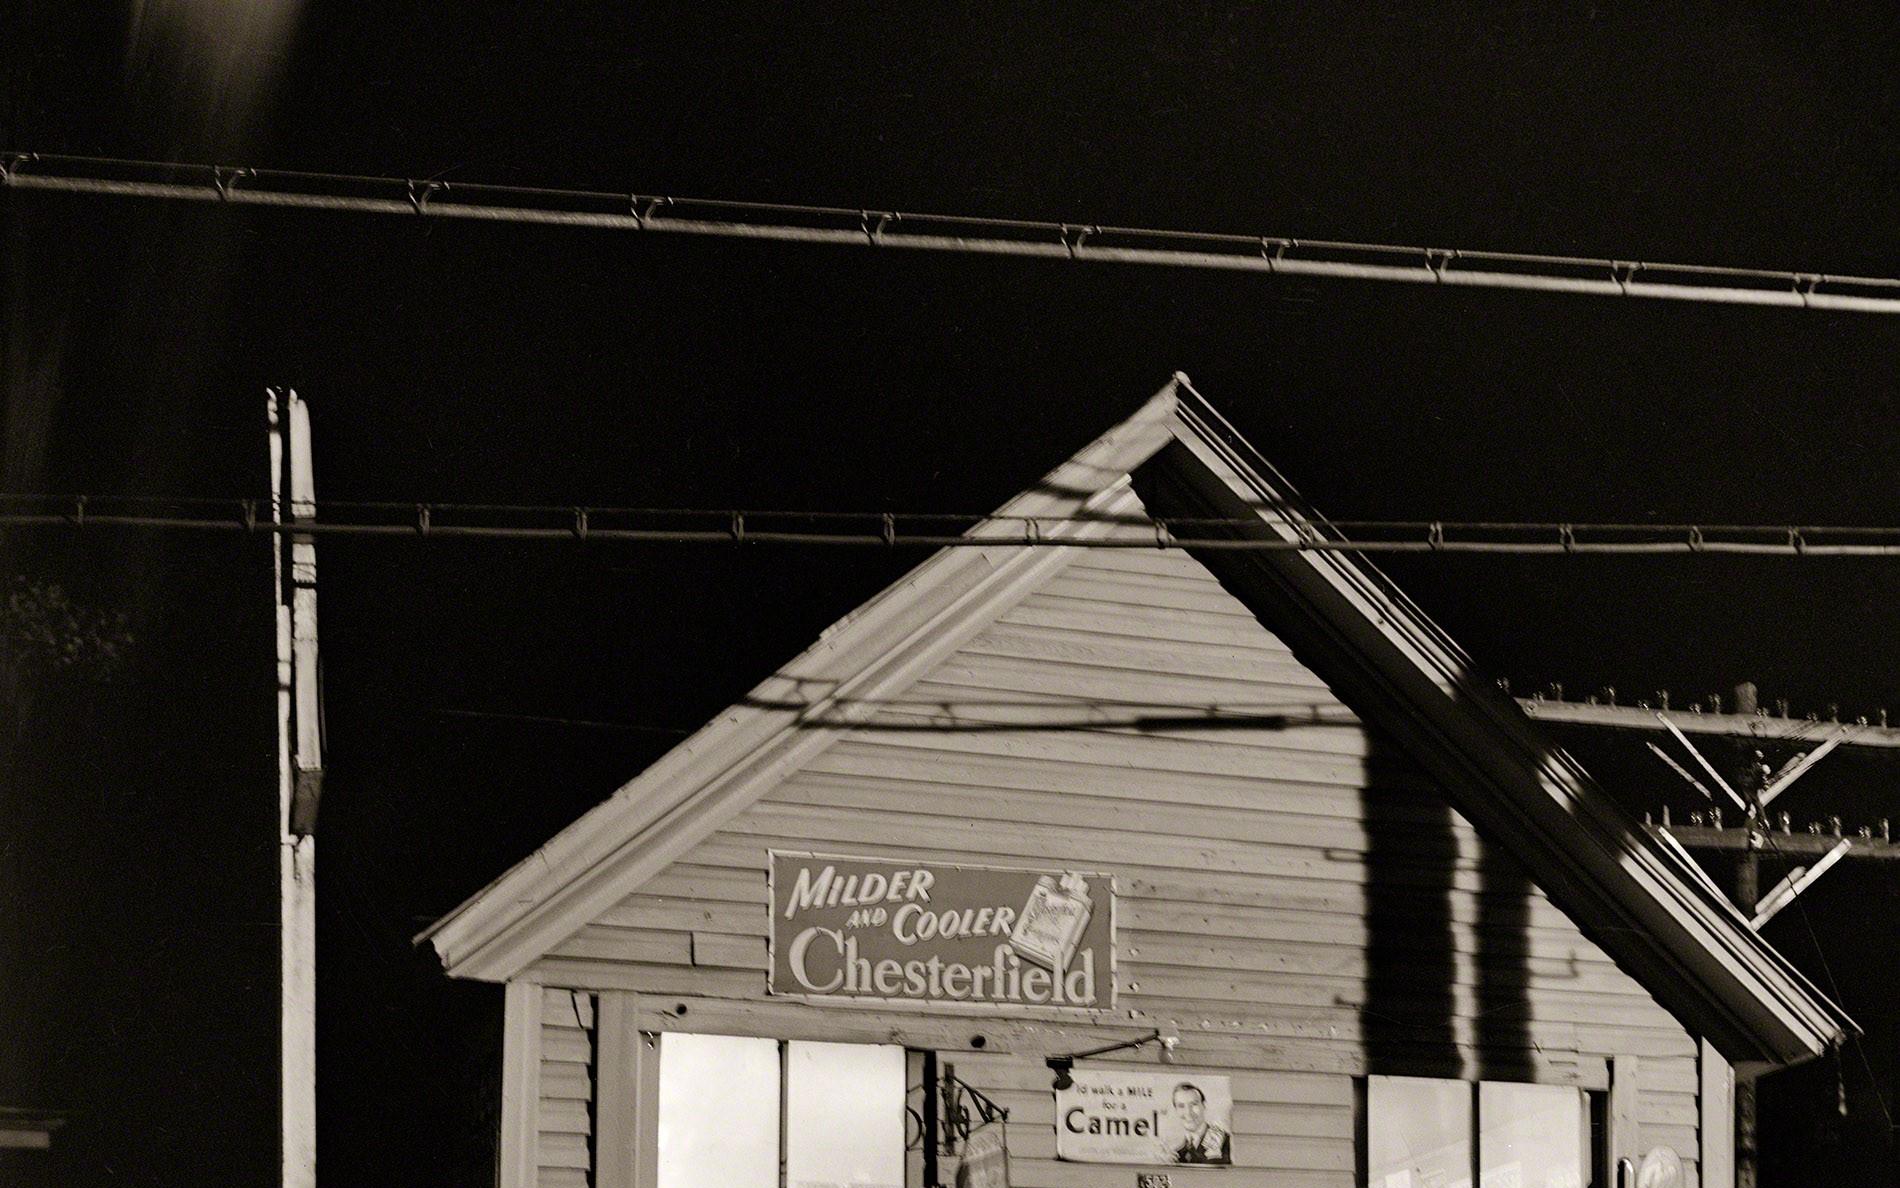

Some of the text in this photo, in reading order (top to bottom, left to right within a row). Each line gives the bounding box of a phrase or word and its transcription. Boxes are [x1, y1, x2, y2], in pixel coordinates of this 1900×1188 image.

[784, 866, 935, 921] MILDER
[846, 903, 1017, 946] AND COOLER
[789, 927, 1097, 1007] Chesterfield
[1127, 1085, 1154, 1098] MILE
[1065, 1106, 1159, 1137] Camel
